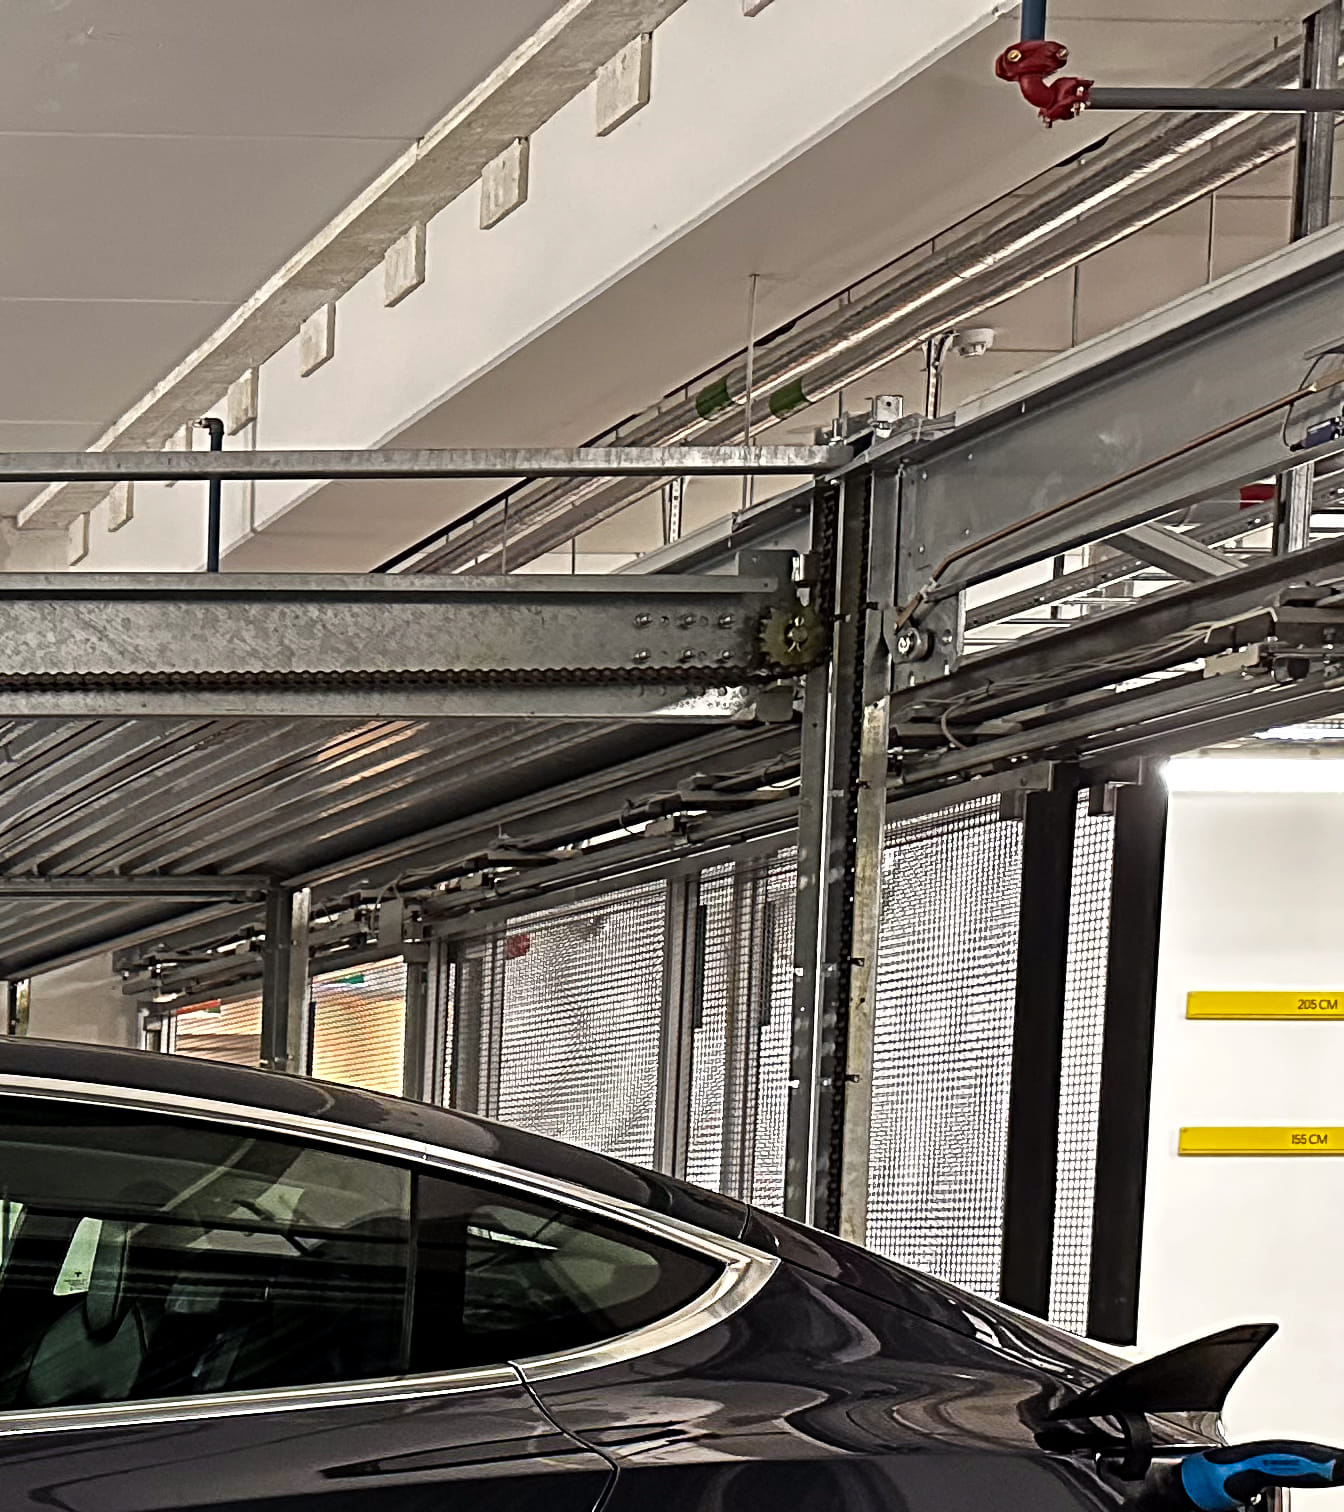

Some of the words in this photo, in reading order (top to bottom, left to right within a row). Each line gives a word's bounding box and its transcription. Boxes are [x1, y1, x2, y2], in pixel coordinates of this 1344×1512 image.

[1297, 999, 1317, 1010] 205
[1318, 999, 1338, 1010] CM
[1291, 1133, 1307, 1145] 155
[1308, 1133, 1328, 1145] CM
